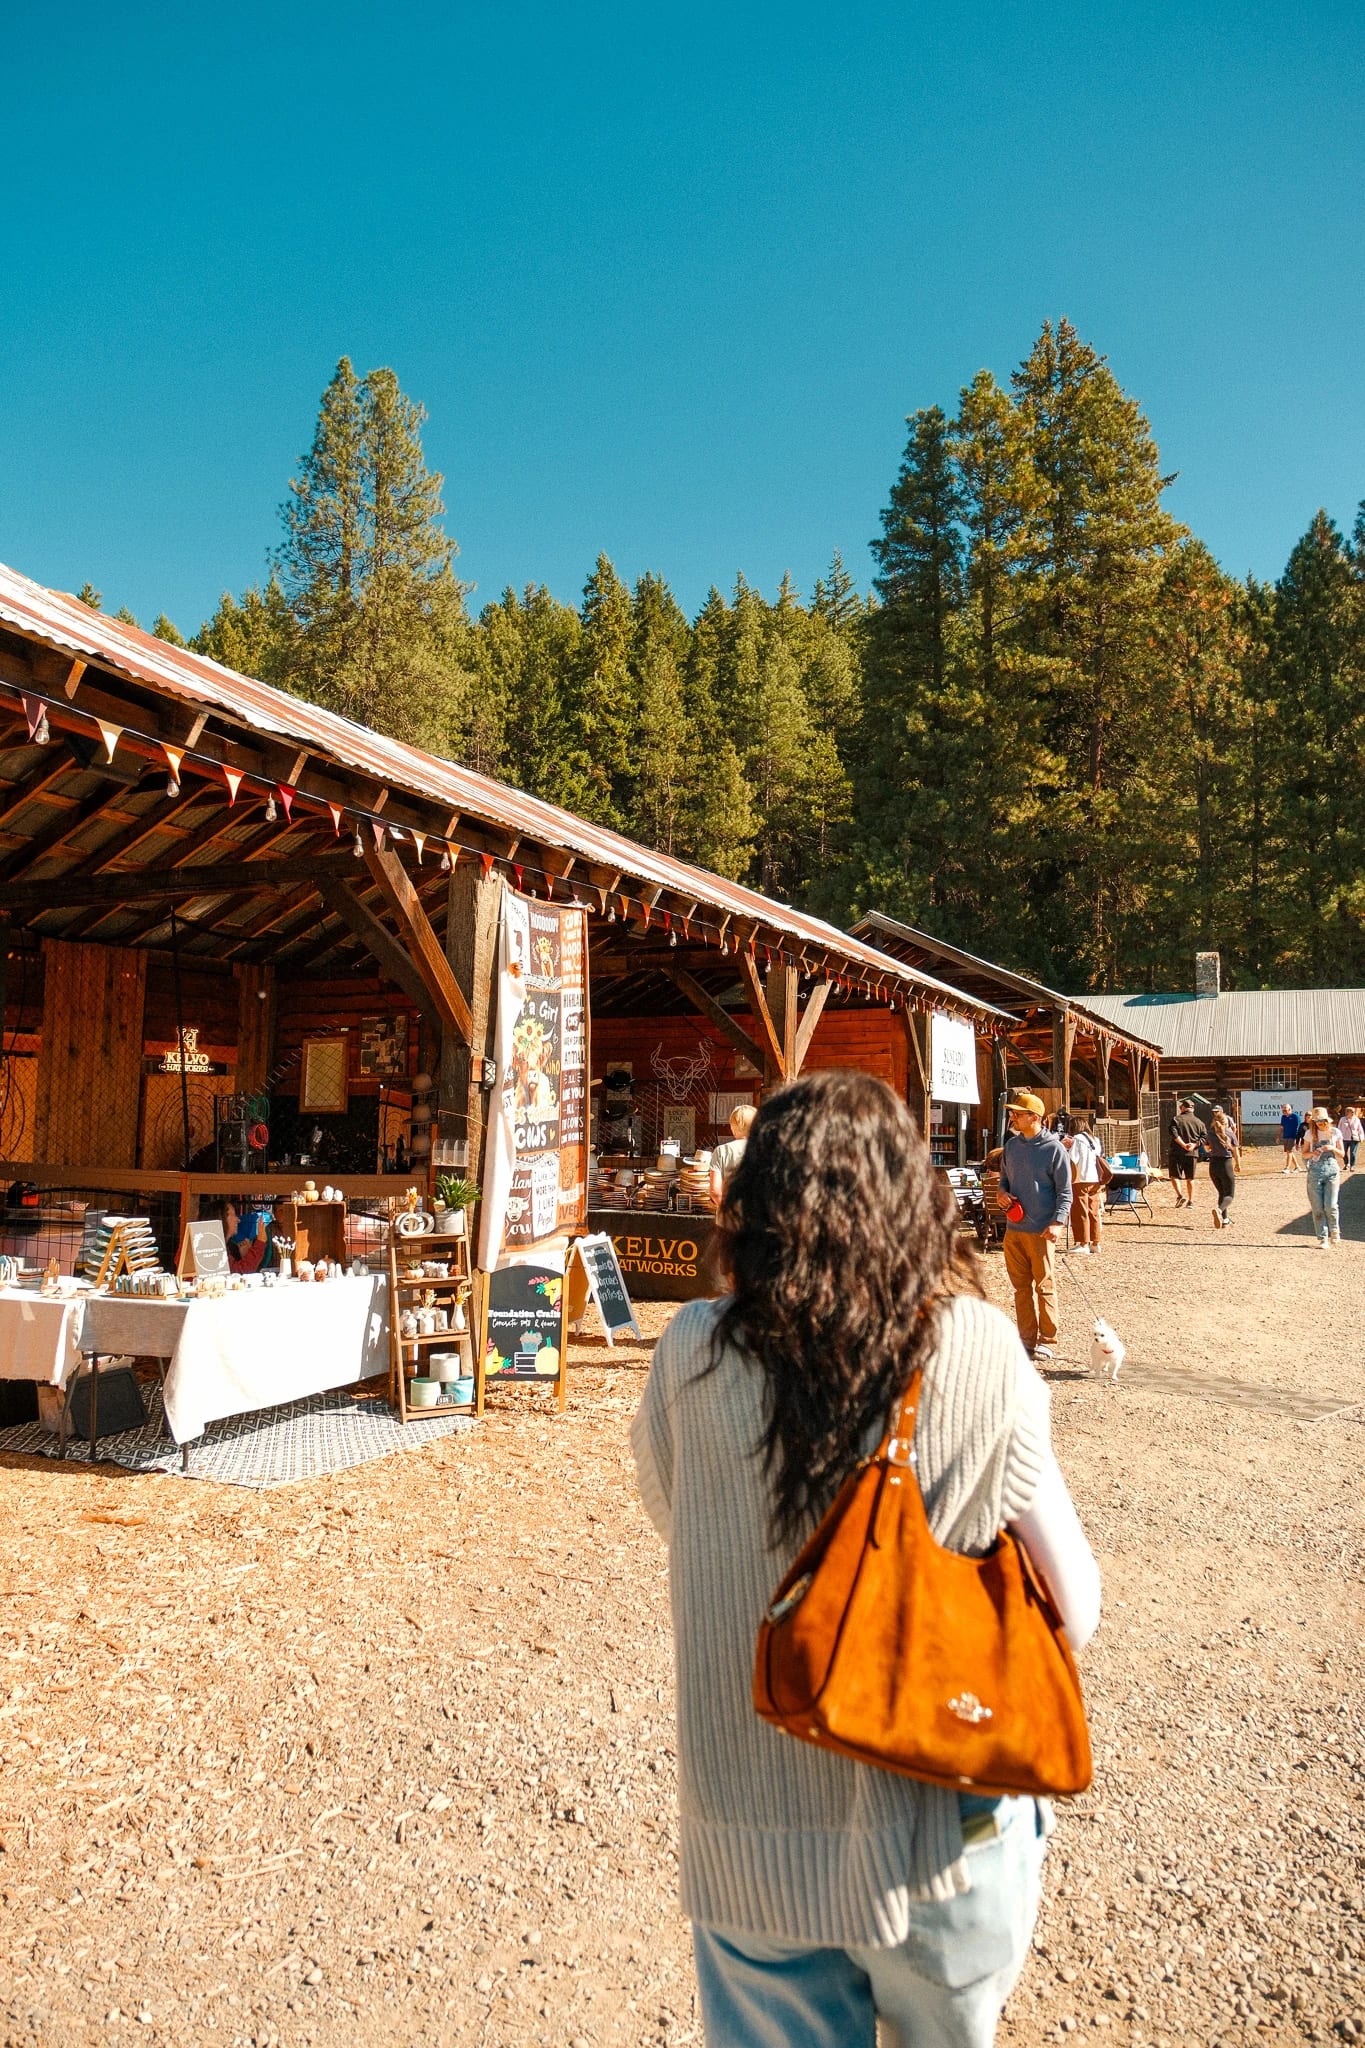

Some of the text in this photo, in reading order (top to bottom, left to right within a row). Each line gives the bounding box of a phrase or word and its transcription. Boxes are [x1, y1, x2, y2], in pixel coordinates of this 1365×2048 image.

[528, 1001, 536, 1016] a
[540, 1000, 559, 1024] Girl
[166, 1051, 210, 1066] KELVO
[571, 1086, 585, 1099] YOU
[515, 1124, 547, 1149] COWS
[611, 1235, 698, 1261] KELVO
[618, 1258, 698, 1277] ATWORKS
[487, 1309, 561, 1318] Foundation Crafts
